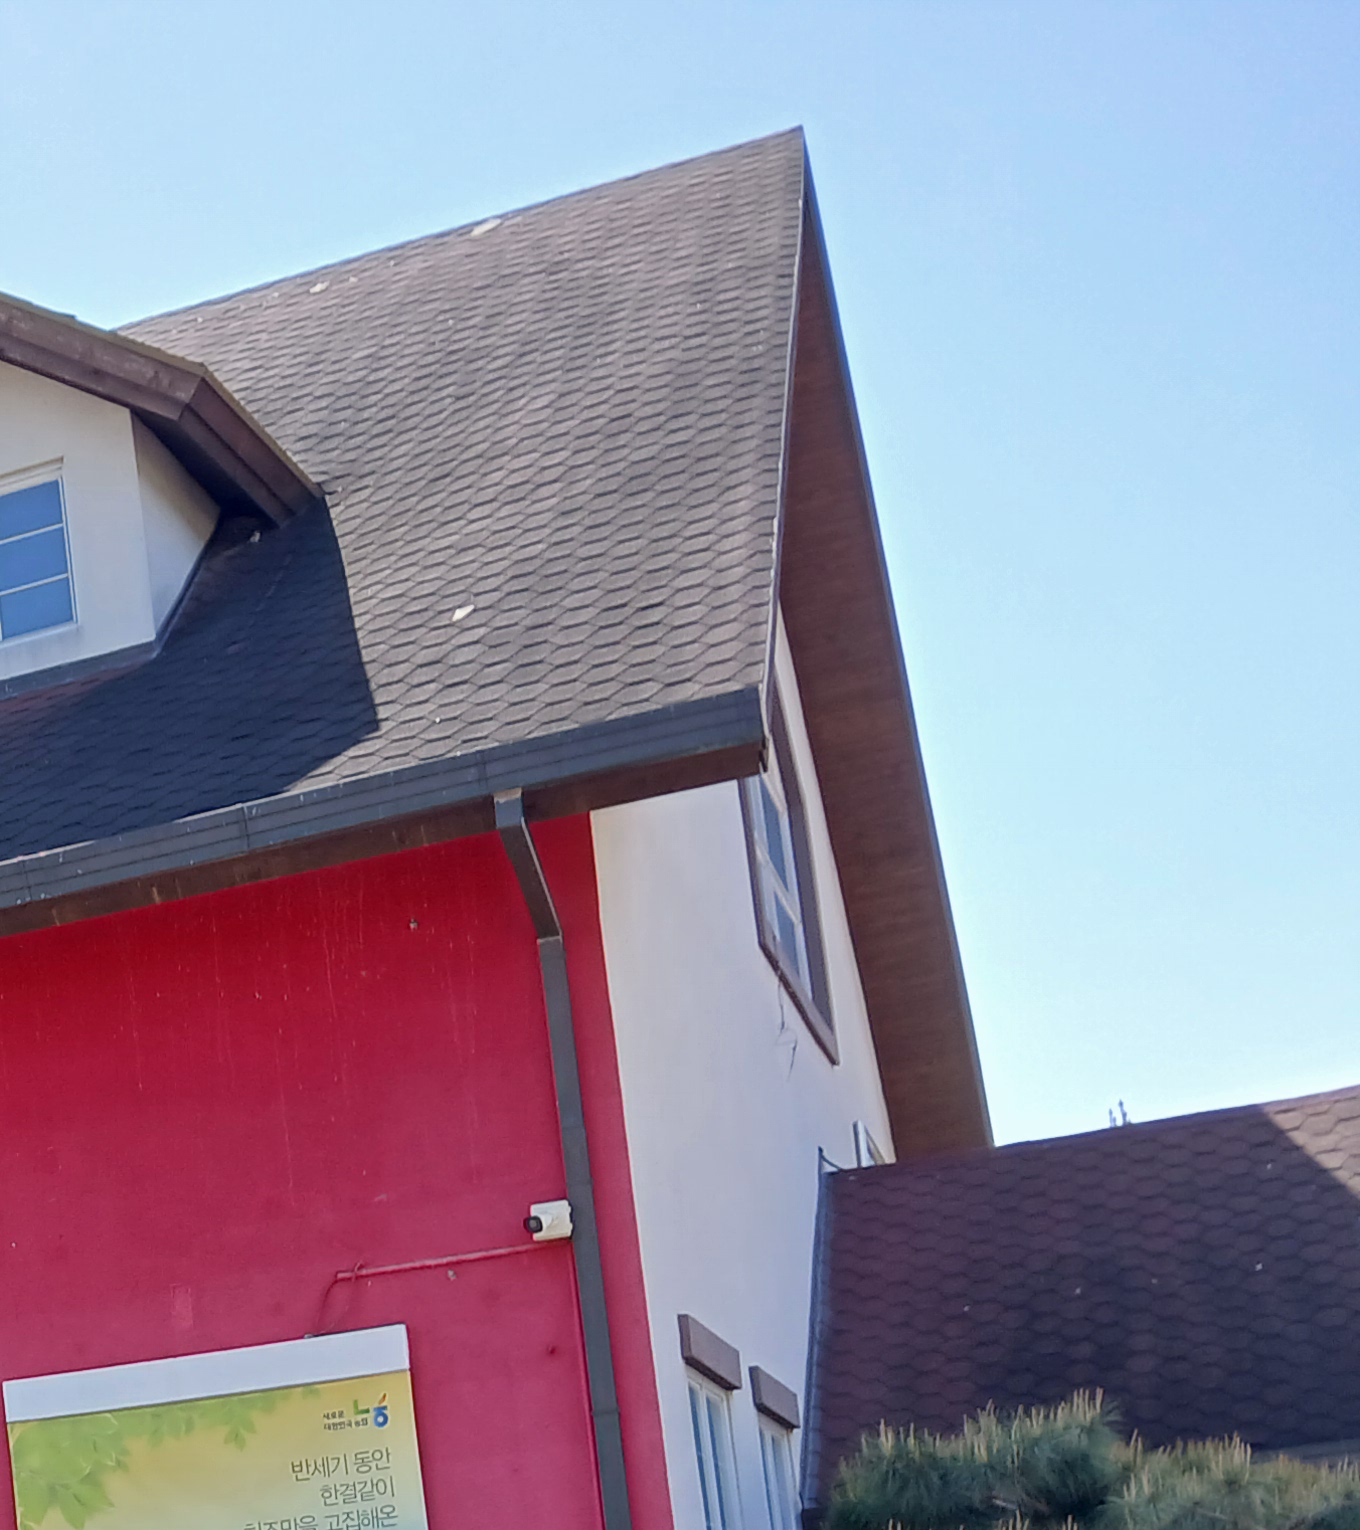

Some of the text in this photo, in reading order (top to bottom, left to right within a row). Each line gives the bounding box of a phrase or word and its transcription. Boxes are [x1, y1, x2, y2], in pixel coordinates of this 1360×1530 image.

[291, 1447, 391, 1482] 반세기 동안
[320, 1476, 395, 1507] 한결같이
